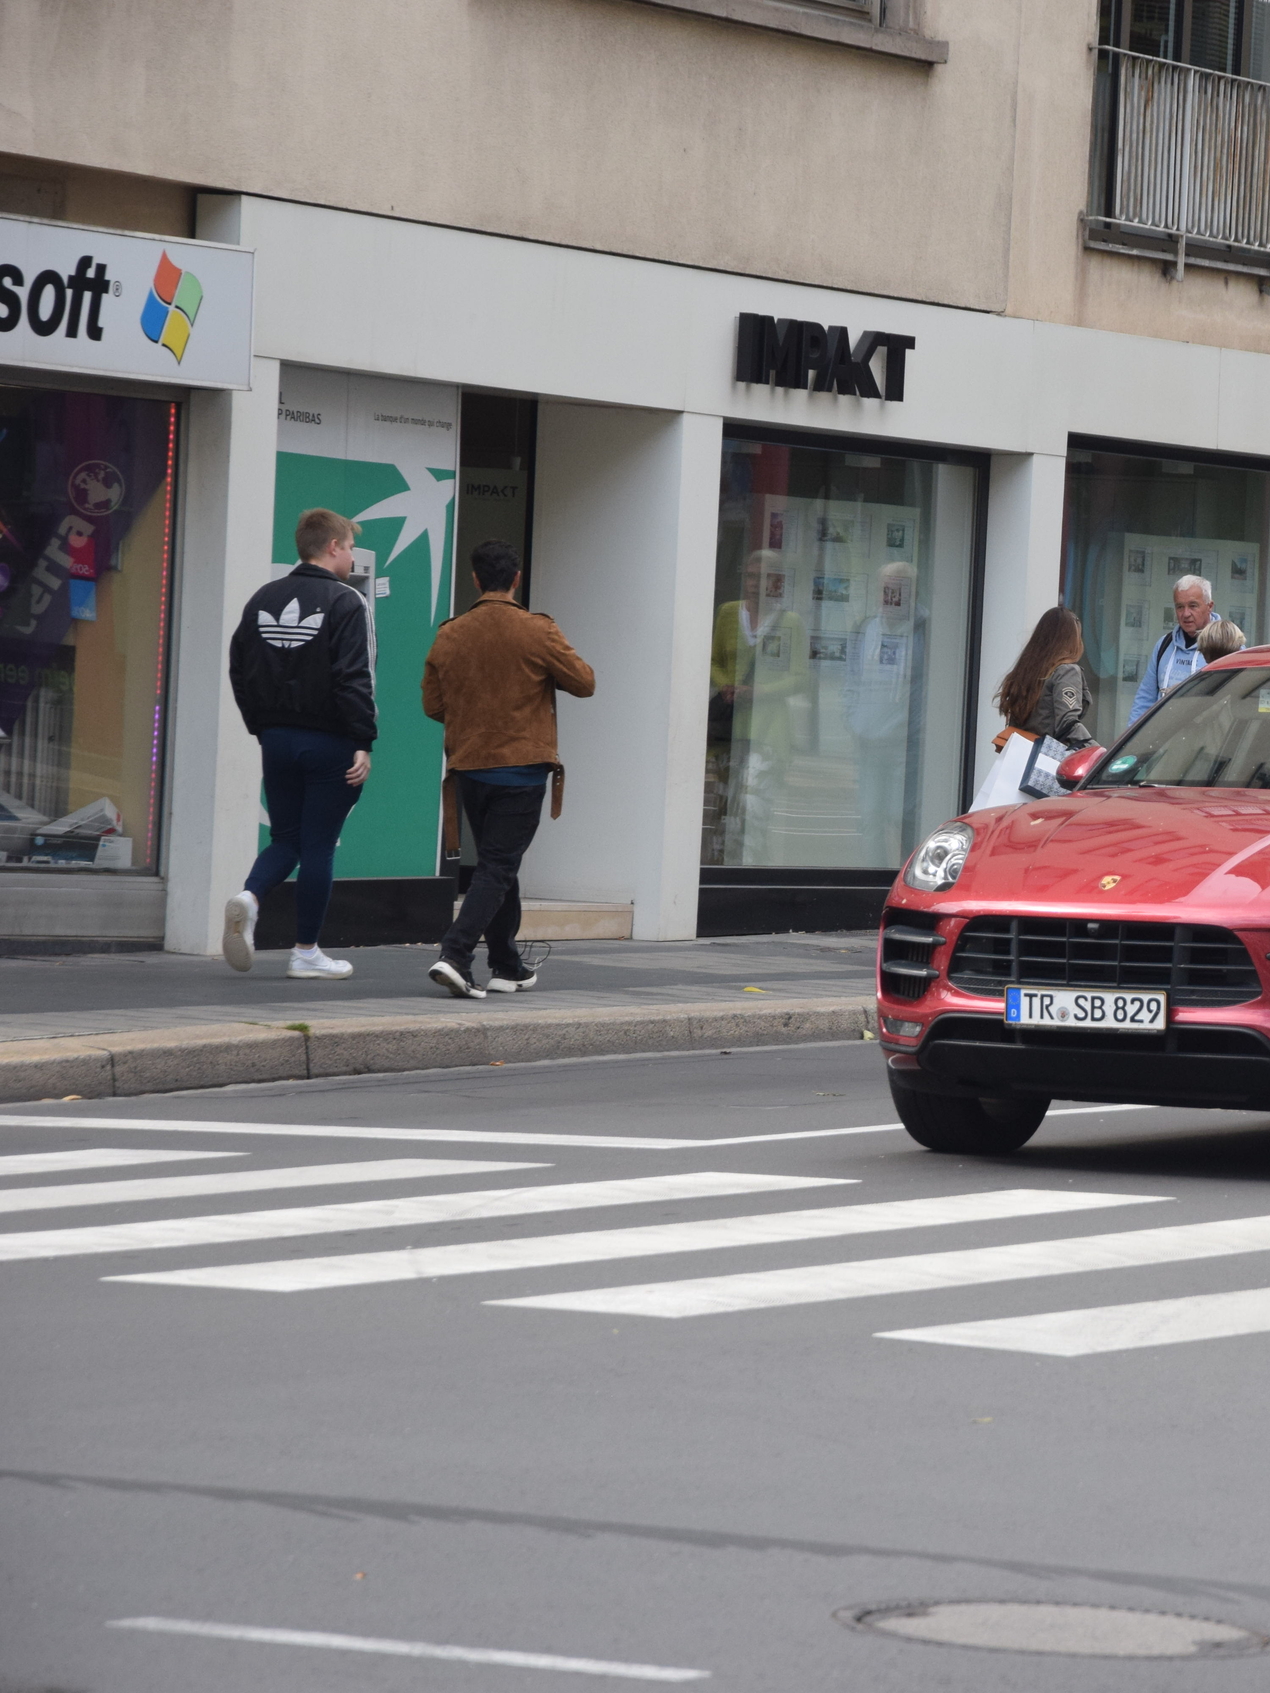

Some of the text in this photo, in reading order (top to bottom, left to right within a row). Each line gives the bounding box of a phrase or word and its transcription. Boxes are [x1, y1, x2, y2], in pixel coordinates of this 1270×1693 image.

[285, 409, 322, 425] PARIBAS
[411, 417, 426, 427] monde
[436, 419, 452, 431] change
[1010, 992, 1162, 1024] D TR SB 829
